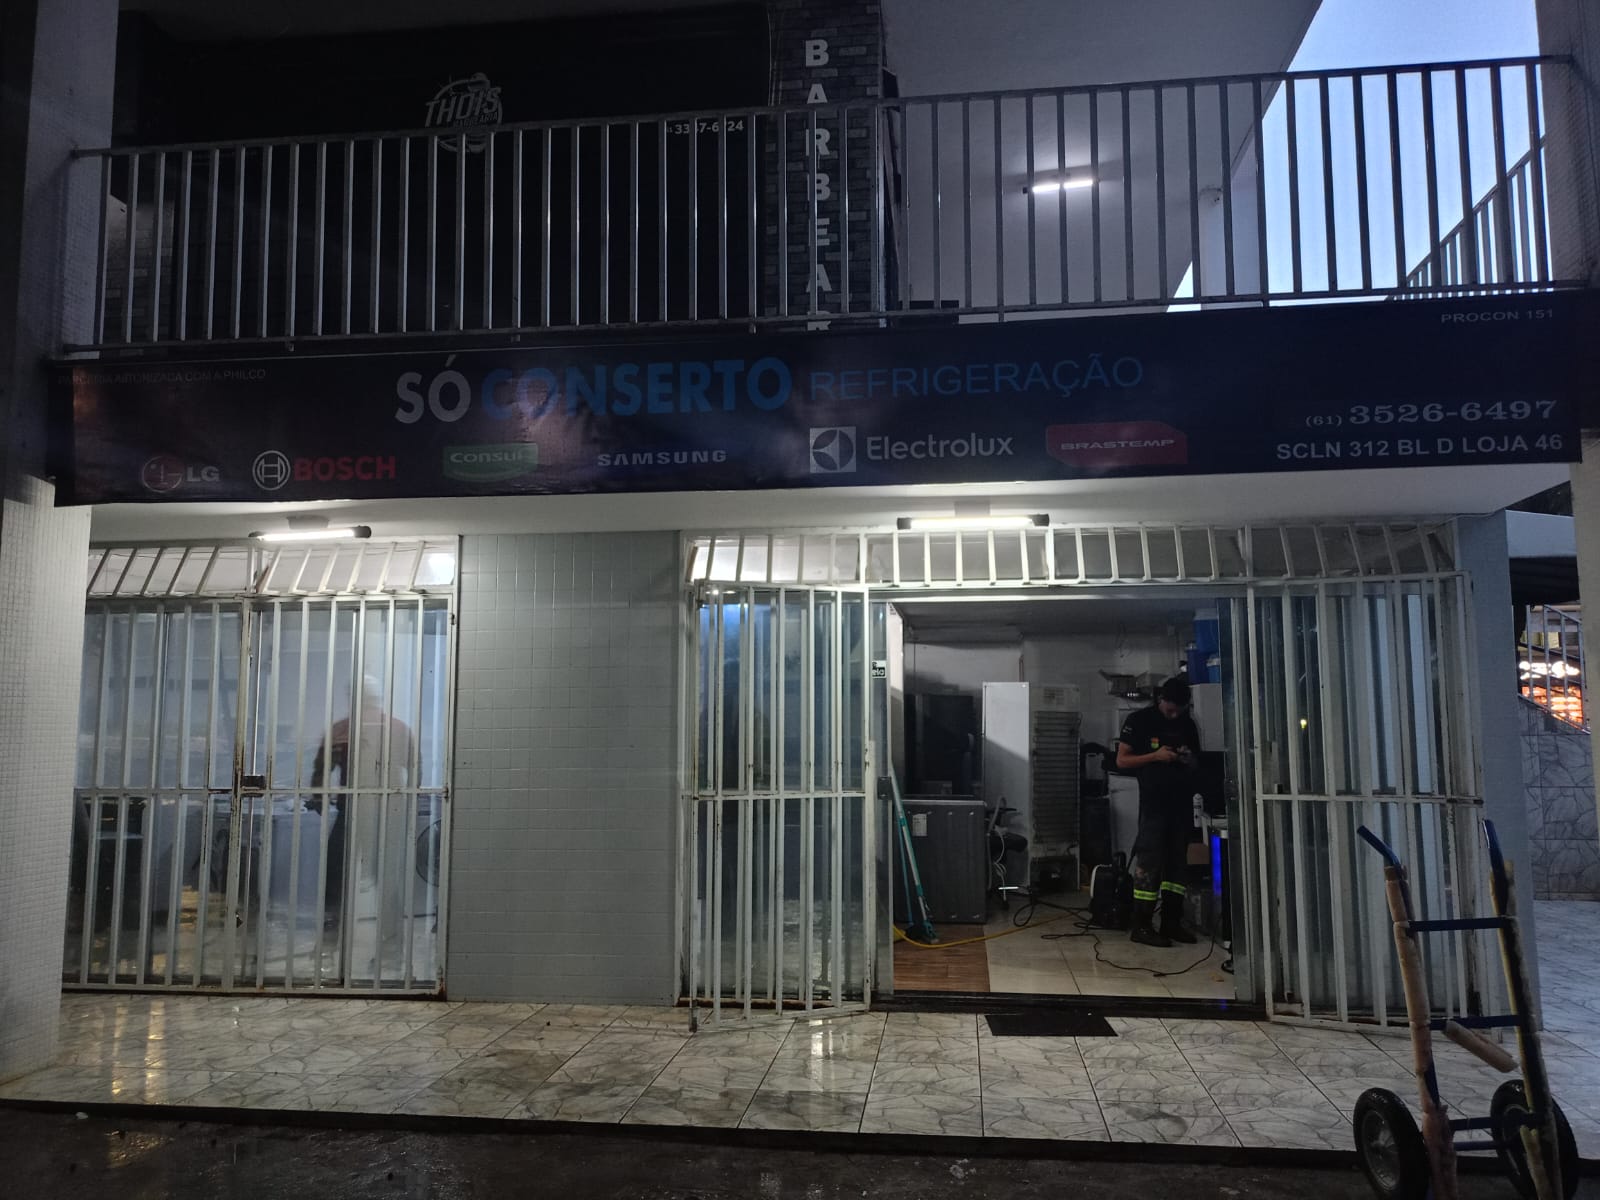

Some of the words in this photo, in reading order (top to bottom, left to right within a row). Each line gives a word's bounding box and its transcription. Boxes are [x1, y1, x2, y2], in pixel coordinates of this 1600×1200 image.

[674, 120, 744, 135] 337-624
[1441, 311, 1520, 323] PROCON
[1528, 308, 1553, 320] 151
[223, 367, 266, 380] PHILCO
[809, 352, 1144, 400] REFRIGERAÇÃO
[394, 354, 472, 424] SÓ
[481, 356, 793, 421] CONSERTO
[1304, 415, 1343, 428] (61)
[1350, 399, 1557, 426] 3526-6497
[866, 432, 1014, 461] Electrolux
[1060, 438, 1175, 451] BRASTEMP
[1276, 441, 1342, 461] SCLN
[1349, 440, 1390, 458] 312
[1397, 438, 1430, 457] BL
[1436, 437, 1454, 455] D
[1462, 434, 1529, 454] LOJA
[1534, 433, 1563, 451] 46
[293, 455, 397, 481] BOSCH
[598, 450, 728, 467] SAMSUNG
[186, 466, 220, 482] LG
